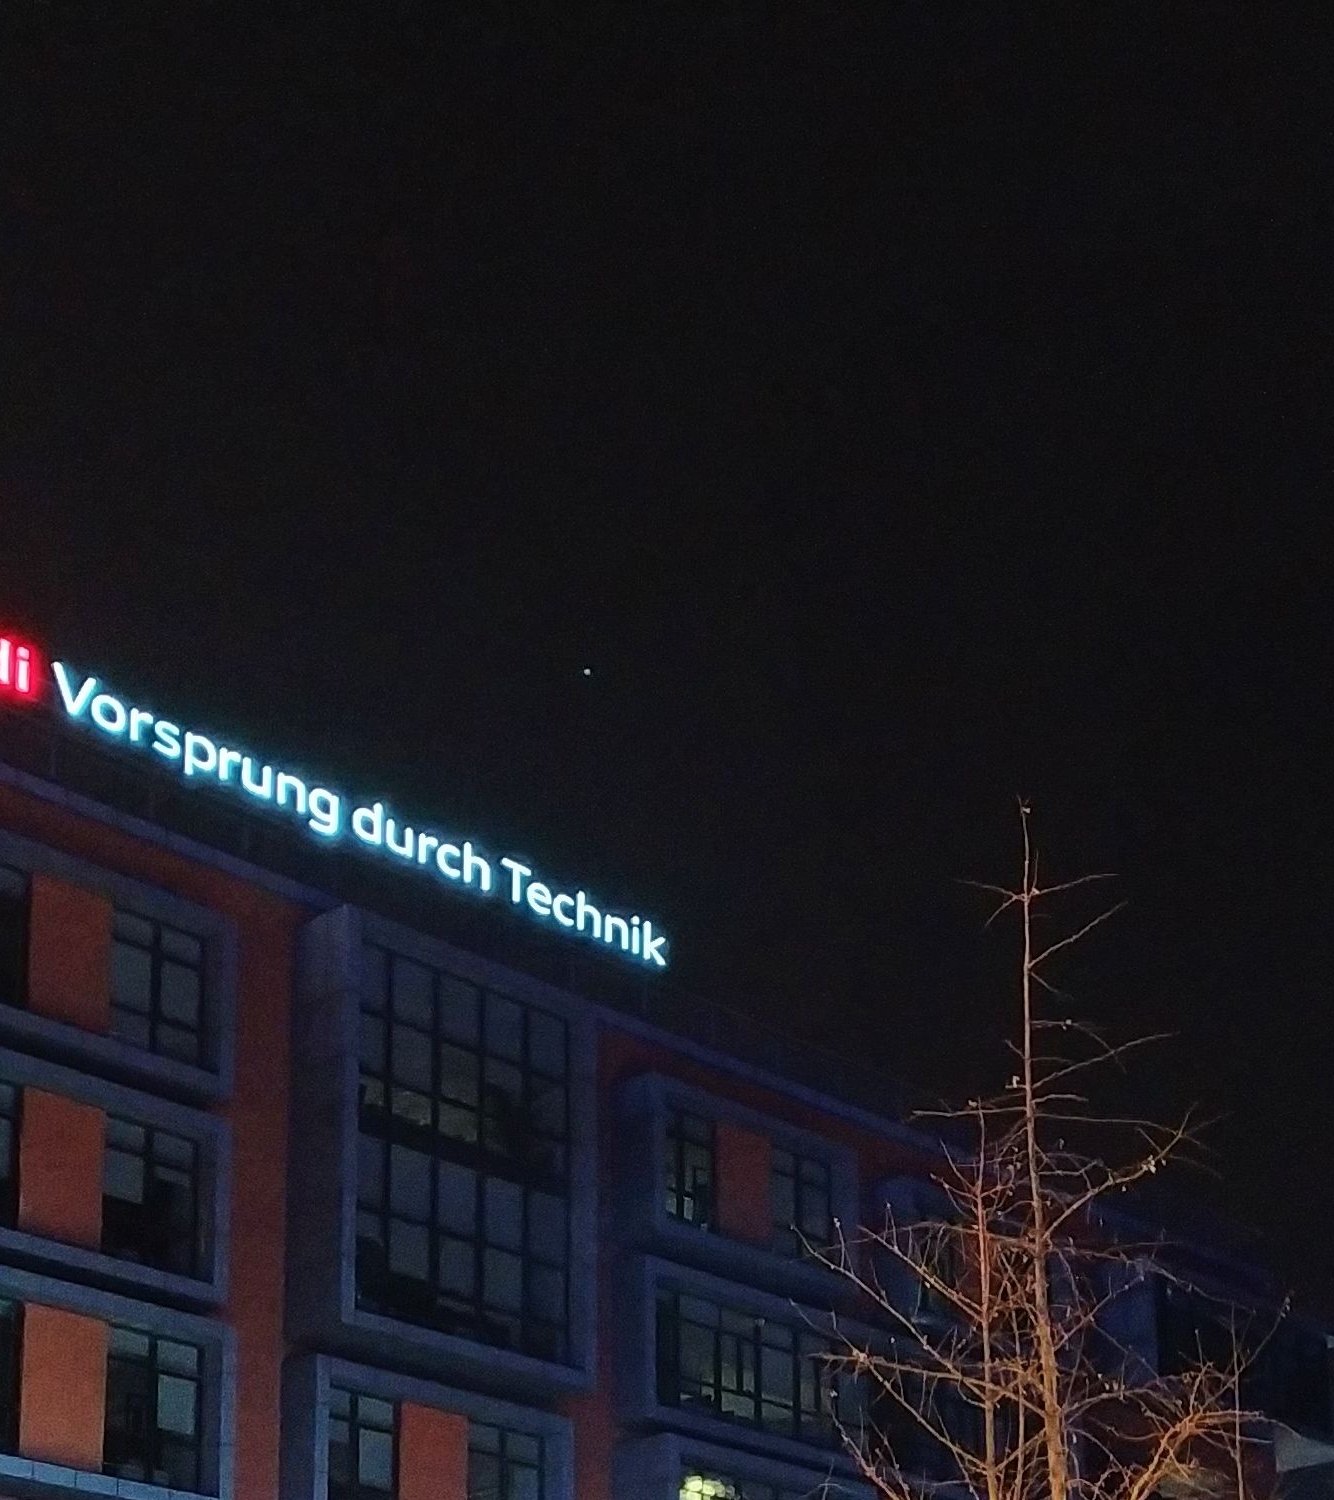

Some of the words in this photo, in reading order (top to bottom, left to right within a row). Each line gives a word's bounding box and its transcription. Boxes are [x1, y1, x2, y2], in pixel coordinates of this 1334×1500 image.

[50, 661, 341, 836] Vorsprung
[352, 802, 492, 891] durch
[501, 857, 667, 966] Technik
